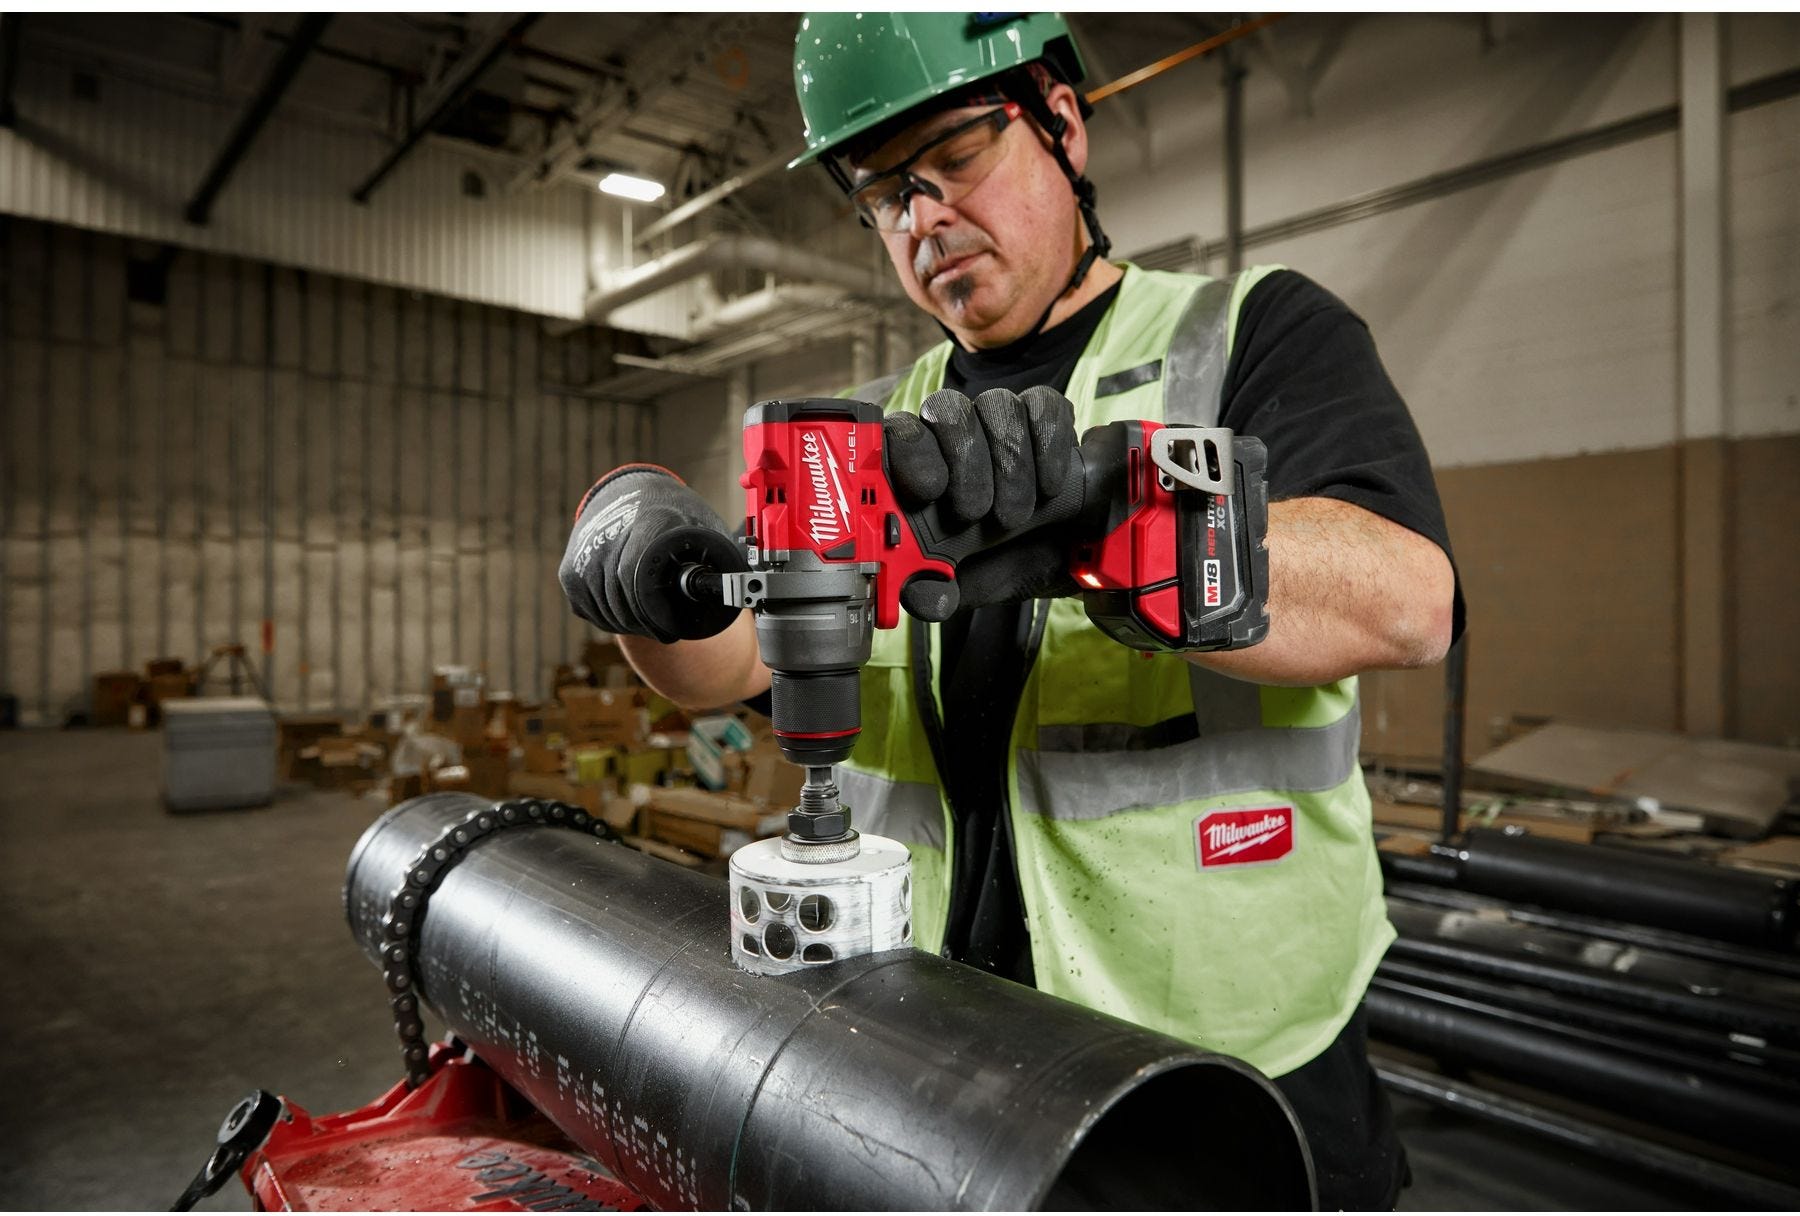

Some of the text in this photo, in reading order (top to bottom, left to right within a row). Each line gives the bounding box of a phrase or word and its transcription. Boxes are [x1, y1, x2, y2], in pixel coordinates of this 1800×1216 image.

[848, 424, 856, 473] FUEL
[802, 432, 840, 545] Milwaukee
[1207, 562, 1218, 603] M18
[1203, 814, 1287, 850] Milwaukee
